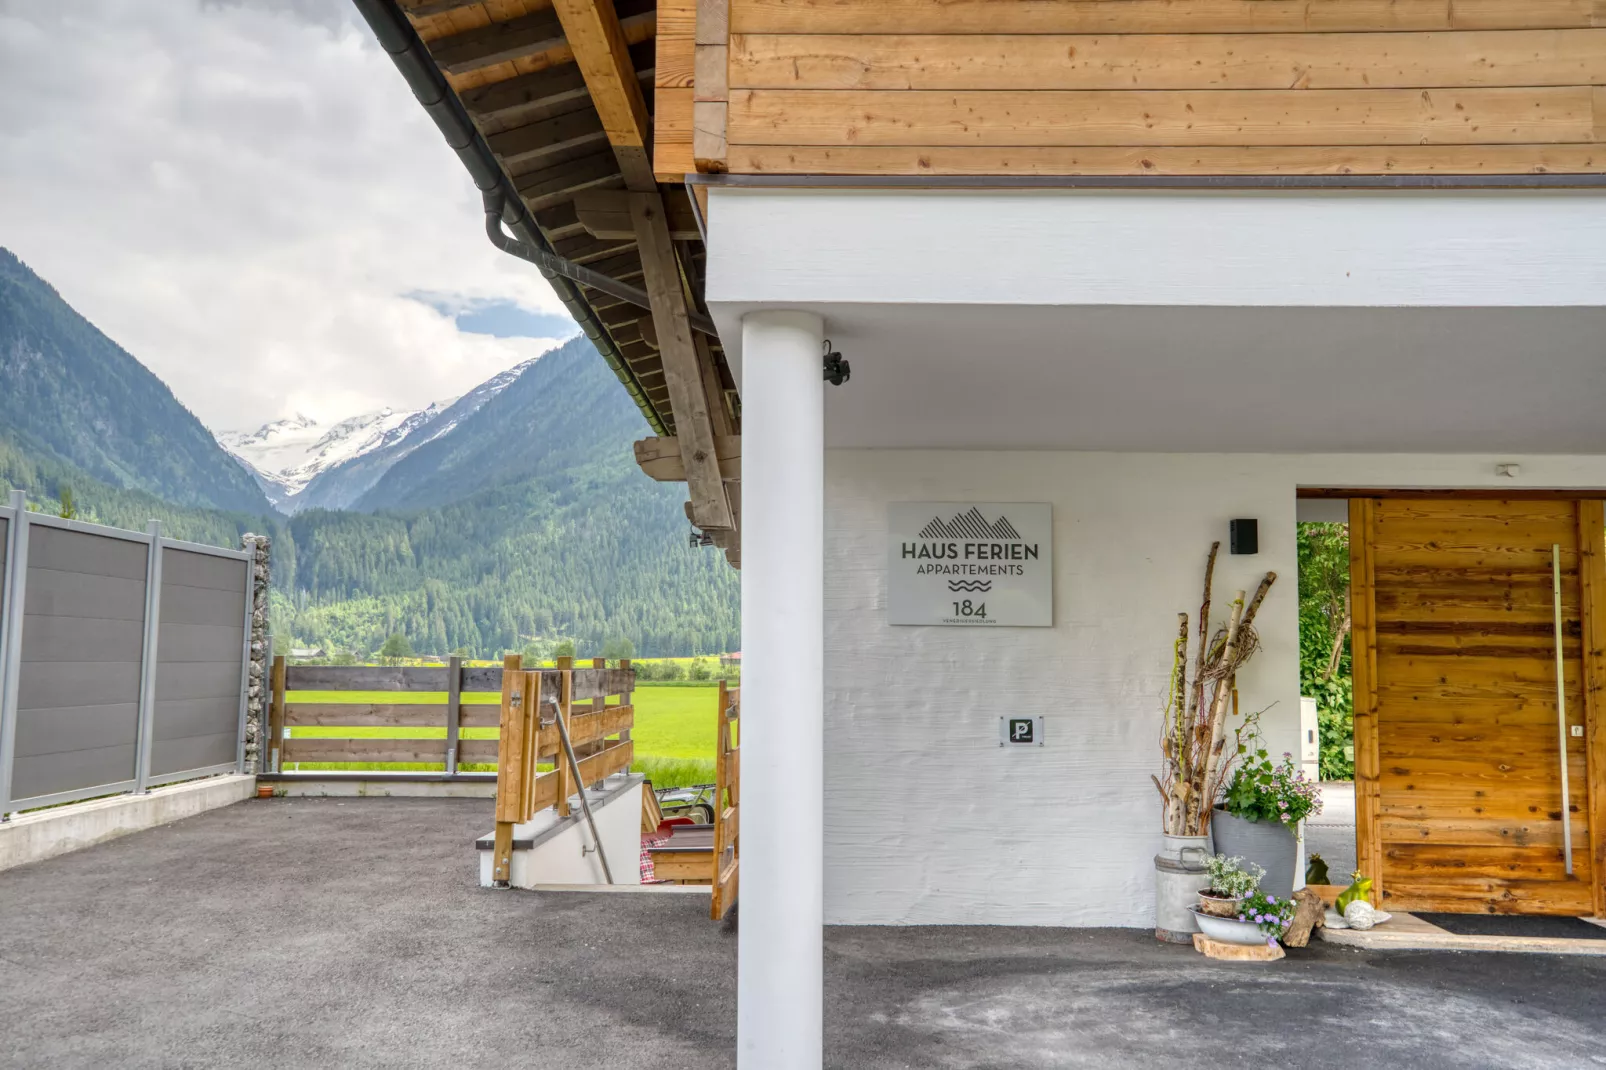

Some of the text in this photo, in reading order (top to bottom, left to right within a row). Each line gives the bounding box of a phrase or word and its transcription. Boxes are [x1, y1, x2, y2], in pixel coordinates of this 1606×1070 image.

[901, 542, 1039, 561] HAUS FERIEN
[916, 563, 1024, 576] APPARTEMENTS
[952, 599, 987, 619] 184
